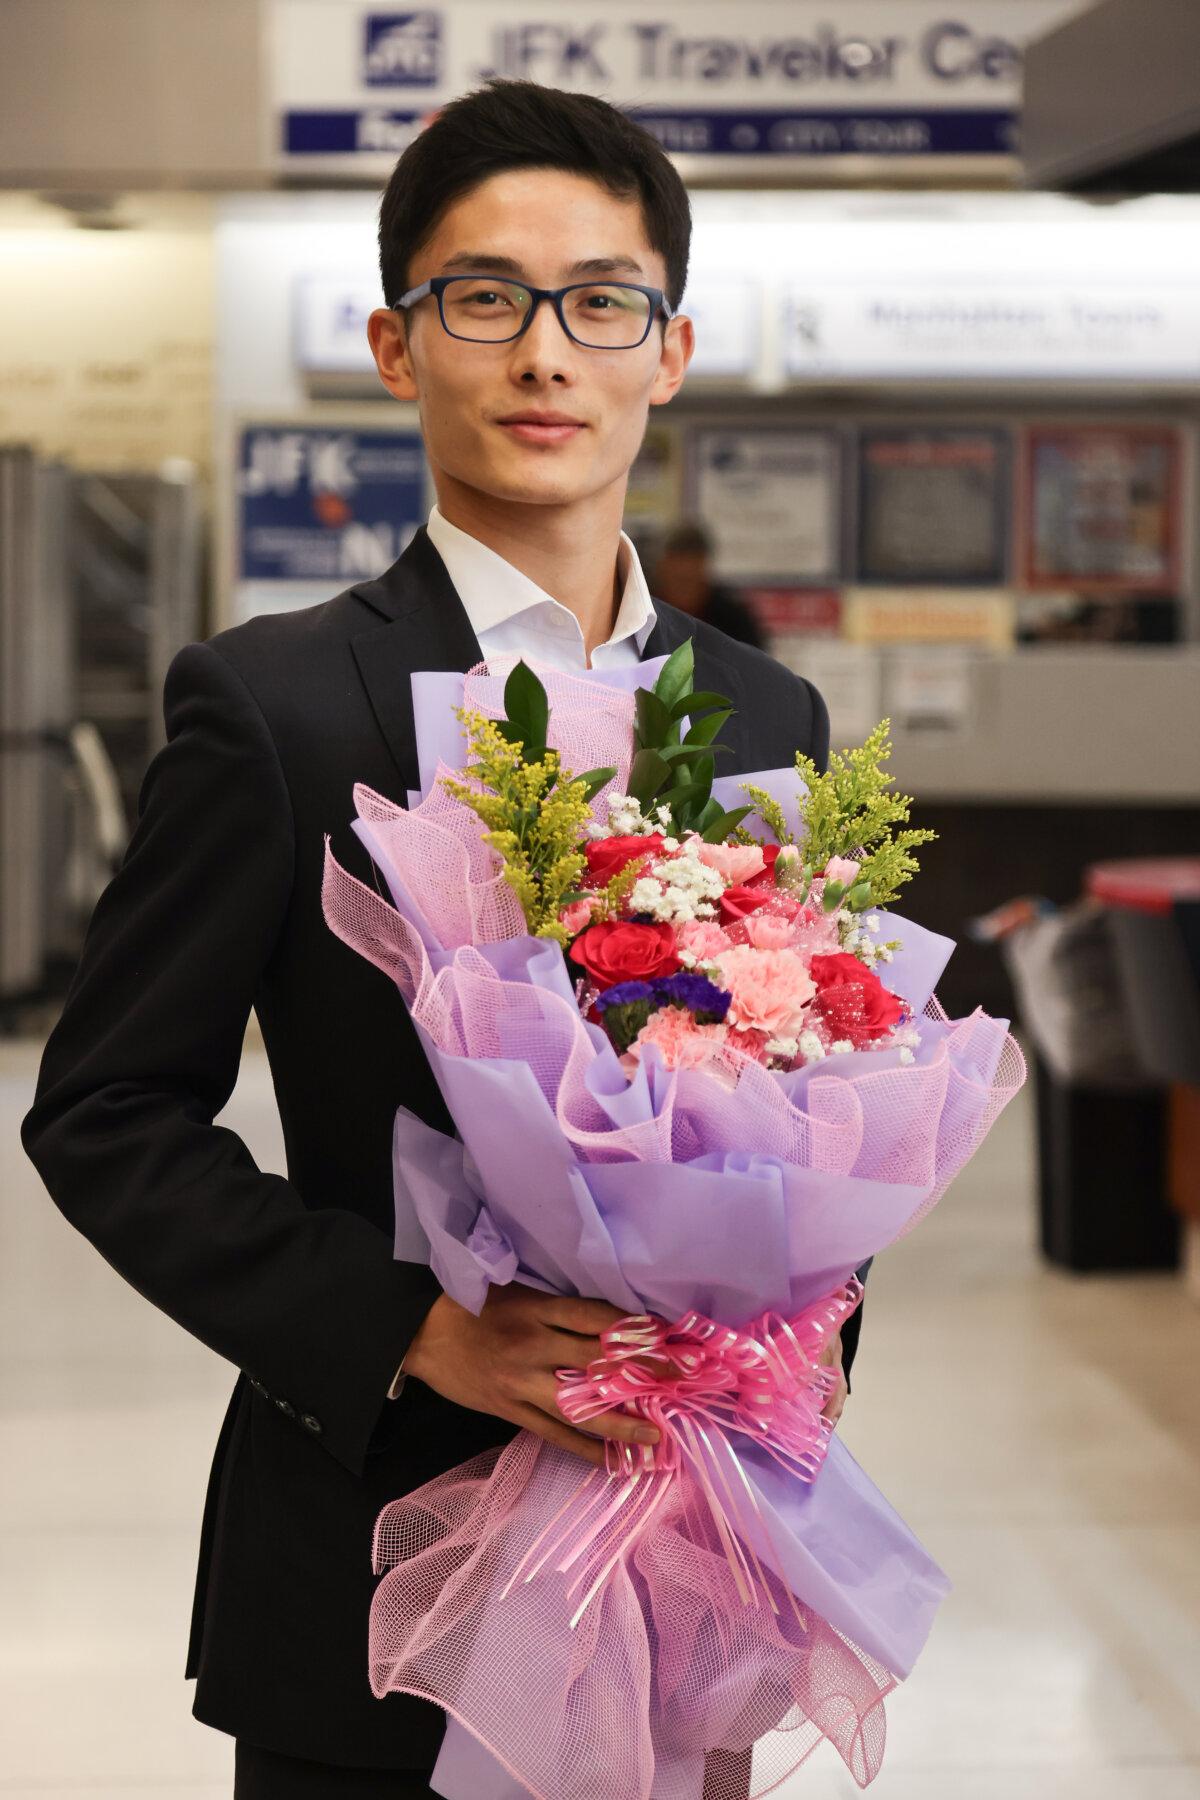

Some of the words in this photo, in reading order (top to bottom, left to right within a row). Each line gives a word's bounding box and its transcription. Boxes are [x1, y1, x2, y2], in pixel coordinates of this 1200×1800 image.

[475, 25, 608, 84] JFK
[634, 22, 896, 82] Traveler
[240, 431, 356, 494] JFK
